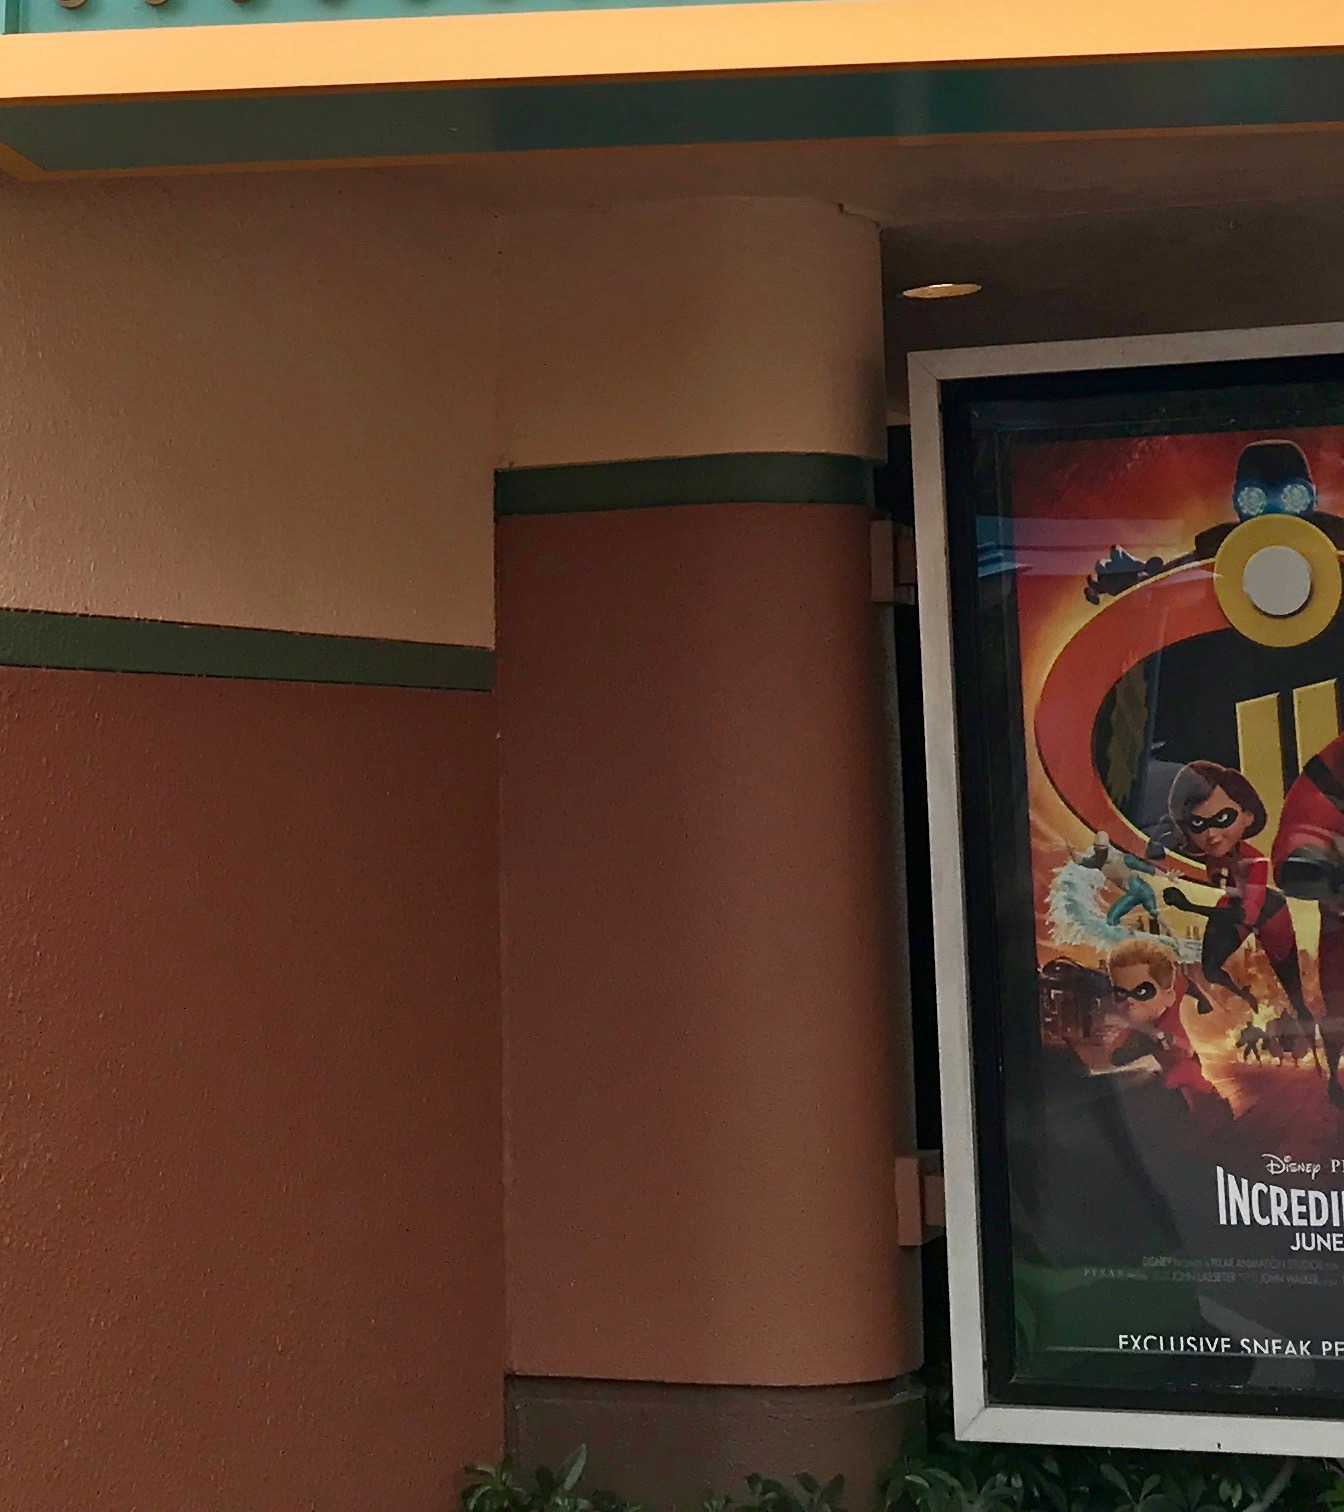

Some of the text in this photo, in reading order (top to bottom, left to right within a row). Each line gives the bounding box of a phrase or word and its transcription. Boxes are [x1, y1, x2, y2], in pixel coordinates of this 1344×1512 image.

[1290, 1232, 1344, 1252] JUNE
[1117, 1333, 1232, 1354] EXCLUSIVE
[1239, 1337, 1313, 1357] SNEAK
